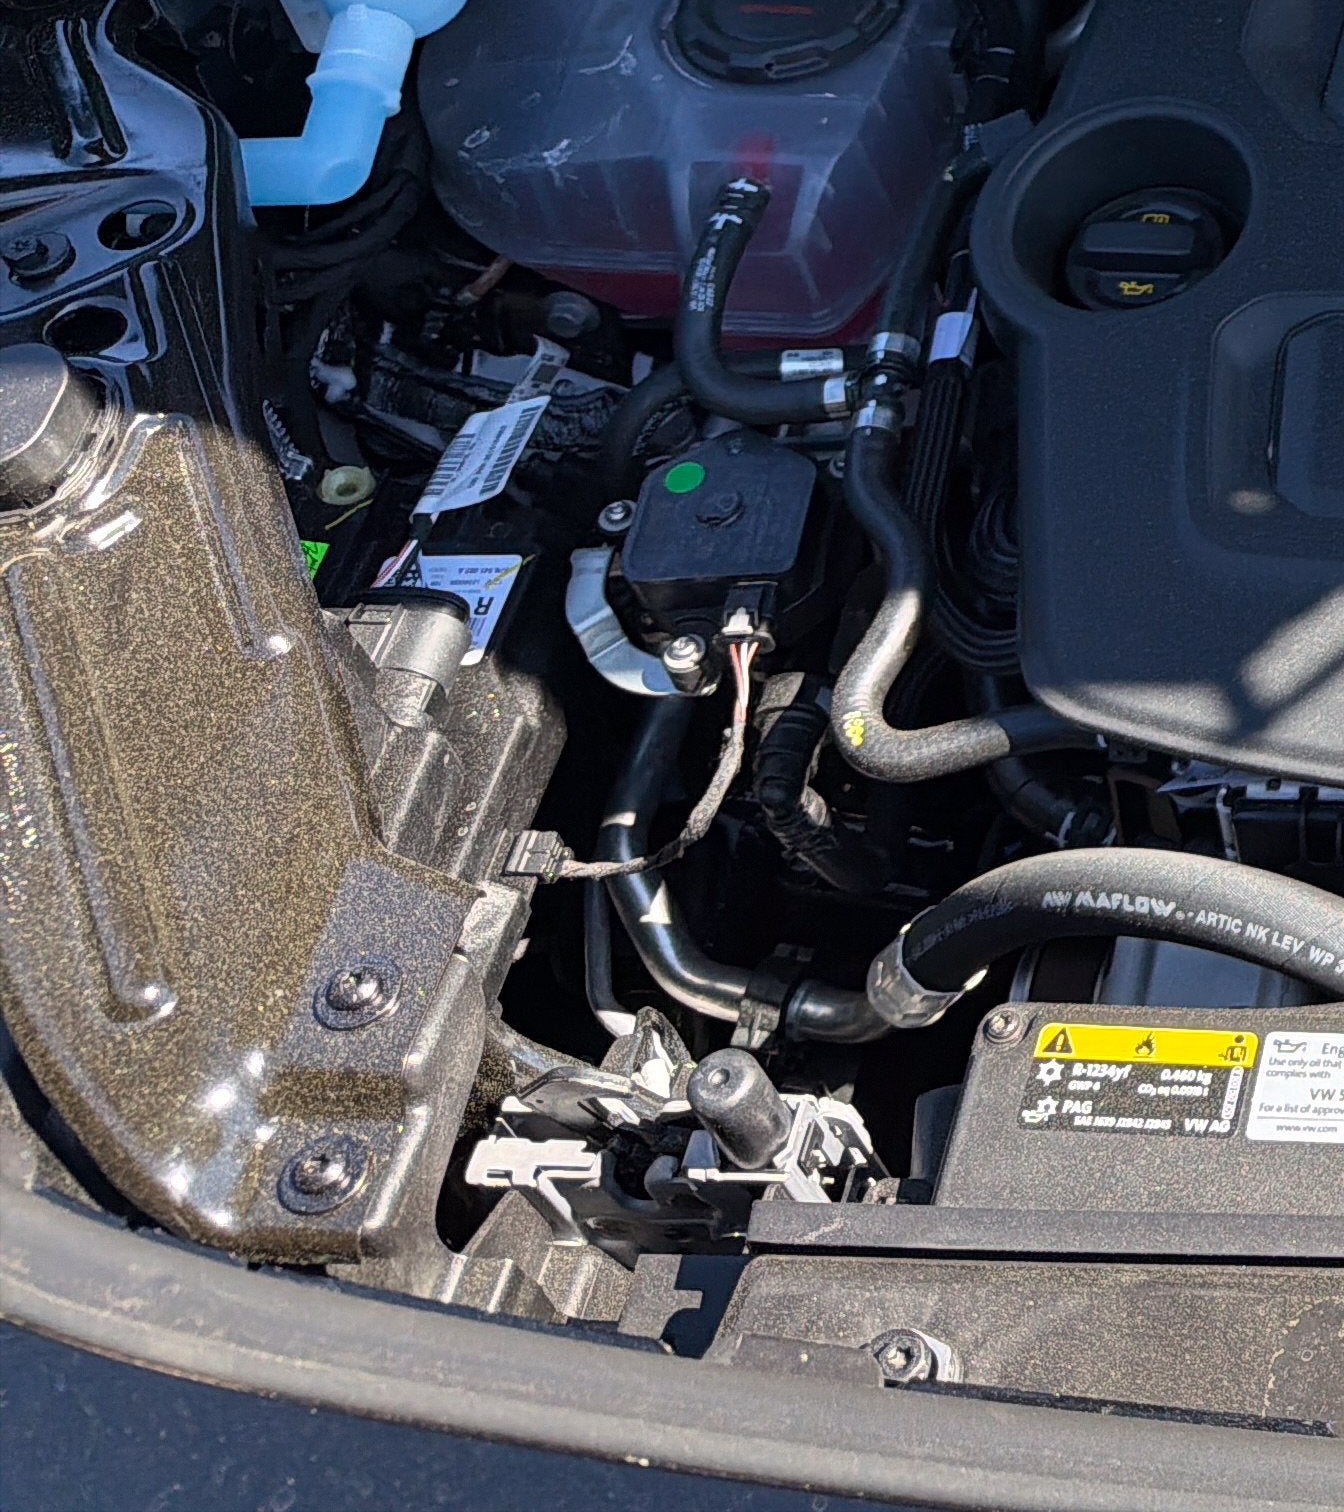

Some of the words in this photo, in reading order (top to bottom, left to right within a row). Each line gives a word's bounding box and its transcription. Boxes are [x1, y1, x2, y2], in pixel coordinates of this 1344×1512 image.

[474, 596, 494, 615] R
[1194, 909, 1243, 934] ARTIC
[1244, 922, 1271, 944] NK
[1271, 930, 1306, 955] LEV
[1308, 945, 1335, 966] WP
[1310, 1088, 1337, 1101] VW
[1061, 1100, 1093, 1114] PAG
